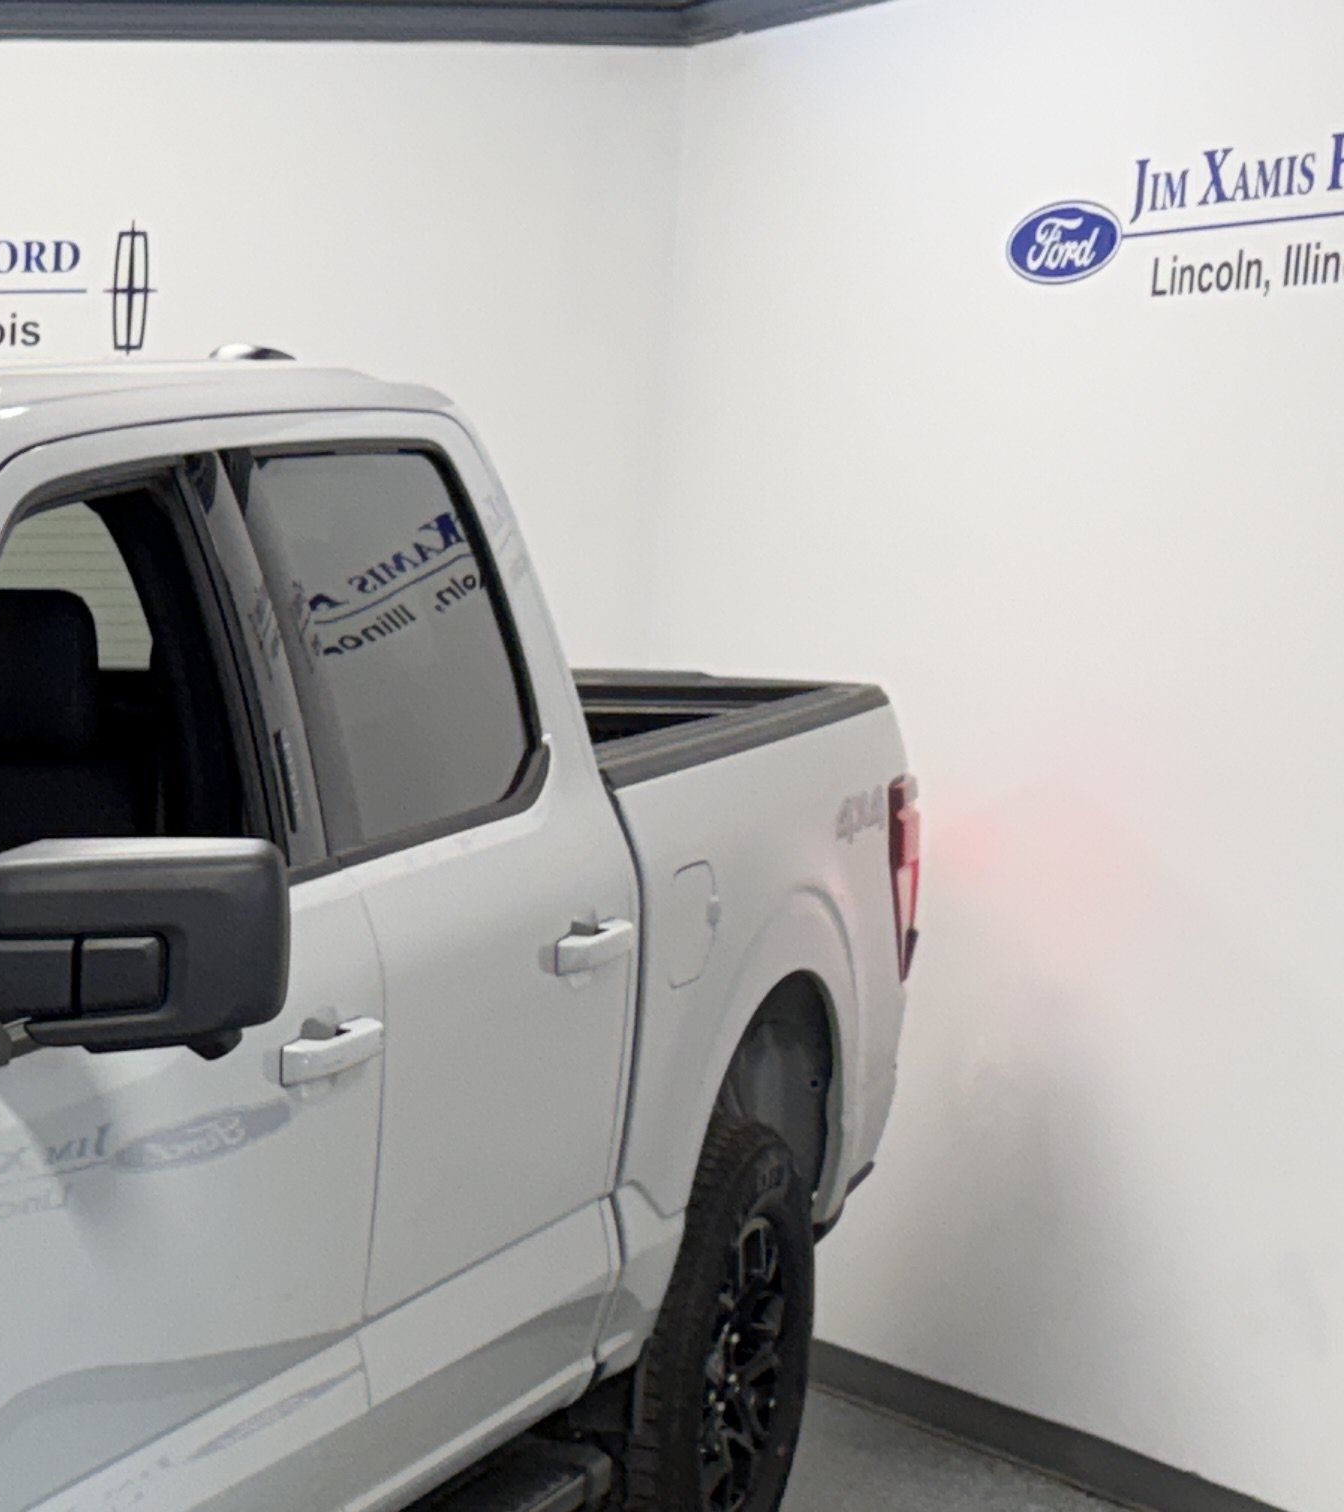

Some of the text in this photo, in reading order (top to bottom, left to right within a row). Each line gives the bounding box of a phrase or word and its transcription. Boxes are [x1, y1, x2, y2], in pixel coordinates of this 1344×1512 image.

[1130, 158, 1190, 224] JIM
[1198, 147, 1316, 206] XAMIS
[1026, 217, 1096, 271] Ford
[1150, 241, 1344, 297] Lincoln, Illin
